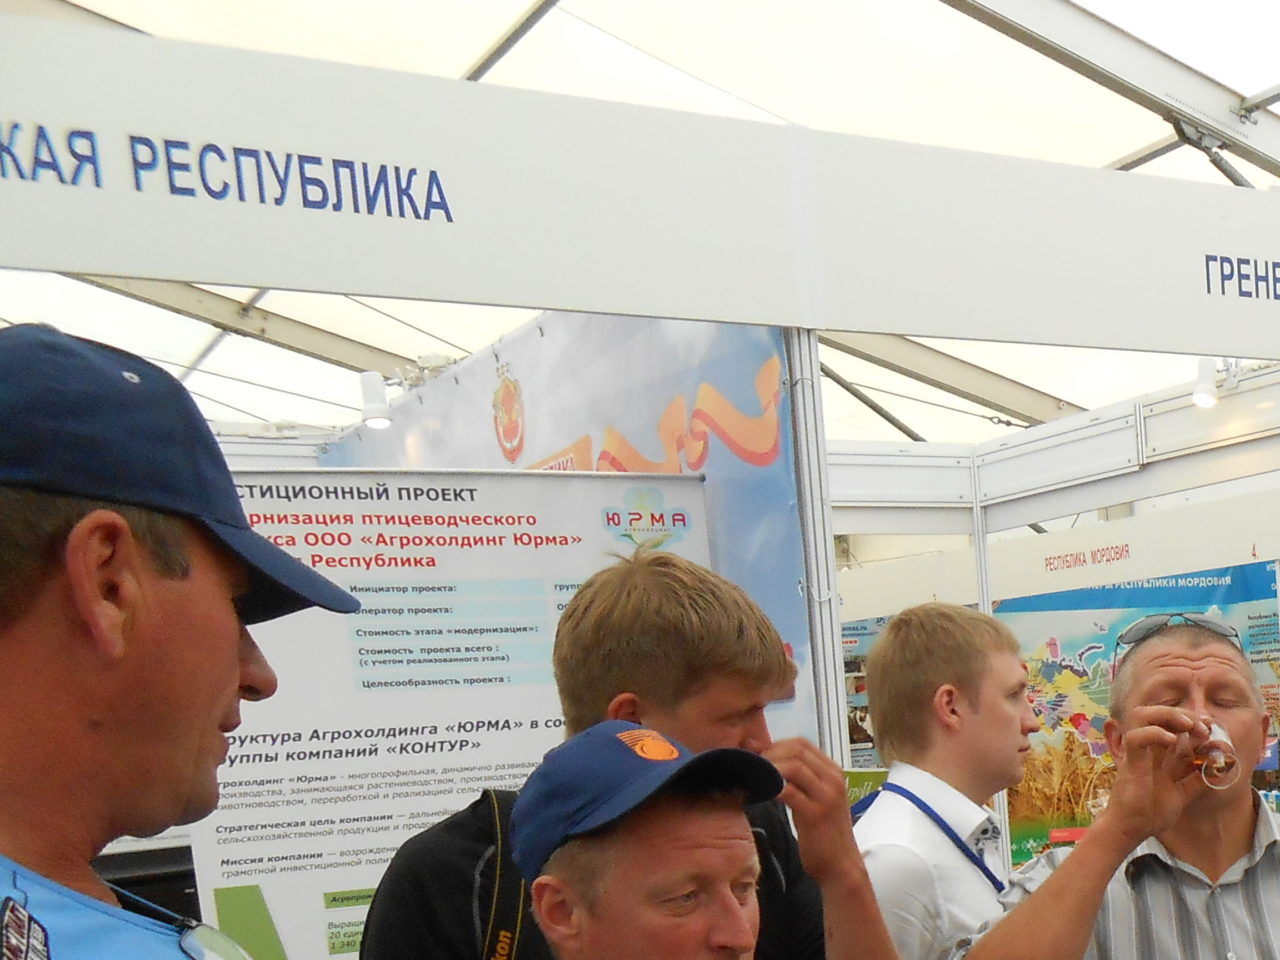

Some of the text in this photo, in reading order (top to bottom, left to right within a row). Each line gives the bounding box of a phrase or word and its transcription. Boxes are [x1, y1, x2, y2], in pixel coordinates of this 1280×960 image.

[129, 134, 454, 223] РЕСПУБЛИКА
[397, 486, 478, 502] ПРОЕКТ
[362, 513, 537, 528] птицеводческого
[606, 511, 687, 527] ЮРМА
[304, 532, 352, 547] ООО
[361, 533, 506, 549] «Агрохолдинг
[513, 532, 583, 548] Юрма»
[311, 553, 437, 570] Республика
[1044, 544, 1130, 572] РЕСПУБЛИКА МОРДОВИЯ
[1178, 575, 1232, 588] МОРДОВИЯ
[350, 585, 457, 595] Инициатор проекта:
[407, 605, 453, 616] проекта:
[356, 625, 538, 637] Стоимость этапа «модернизация»:
[358, 644, 493, 656] Стоимость проекта всего
[407, 656, 479, 666] реализованного
[362, 676, 504, 688] Целесообразность проекта
[309, 725, 438, 743] Агрохолдинга
[445, 719, 523, 734] «ЮРМА»
[530, 719, 539, 729] в
[286, 743, 379, 761] компаний
[386, 739, 481, 755] «КОНТУР»
[288, 774, 336, 786] «Юрма»
[215, 820, 306, 835] Стратегическая
[309, 817, 336, 828] цель
[339, 813, 393, 826] компании
[217, 828, 334, 845] сельскохозяйственной
[220, 856, 264, 867] Миссия
[267, 851, 323, 864] компании
[222, 866, 277, 879] грамотной
[280, 859, 362, 873] инвестиционной
